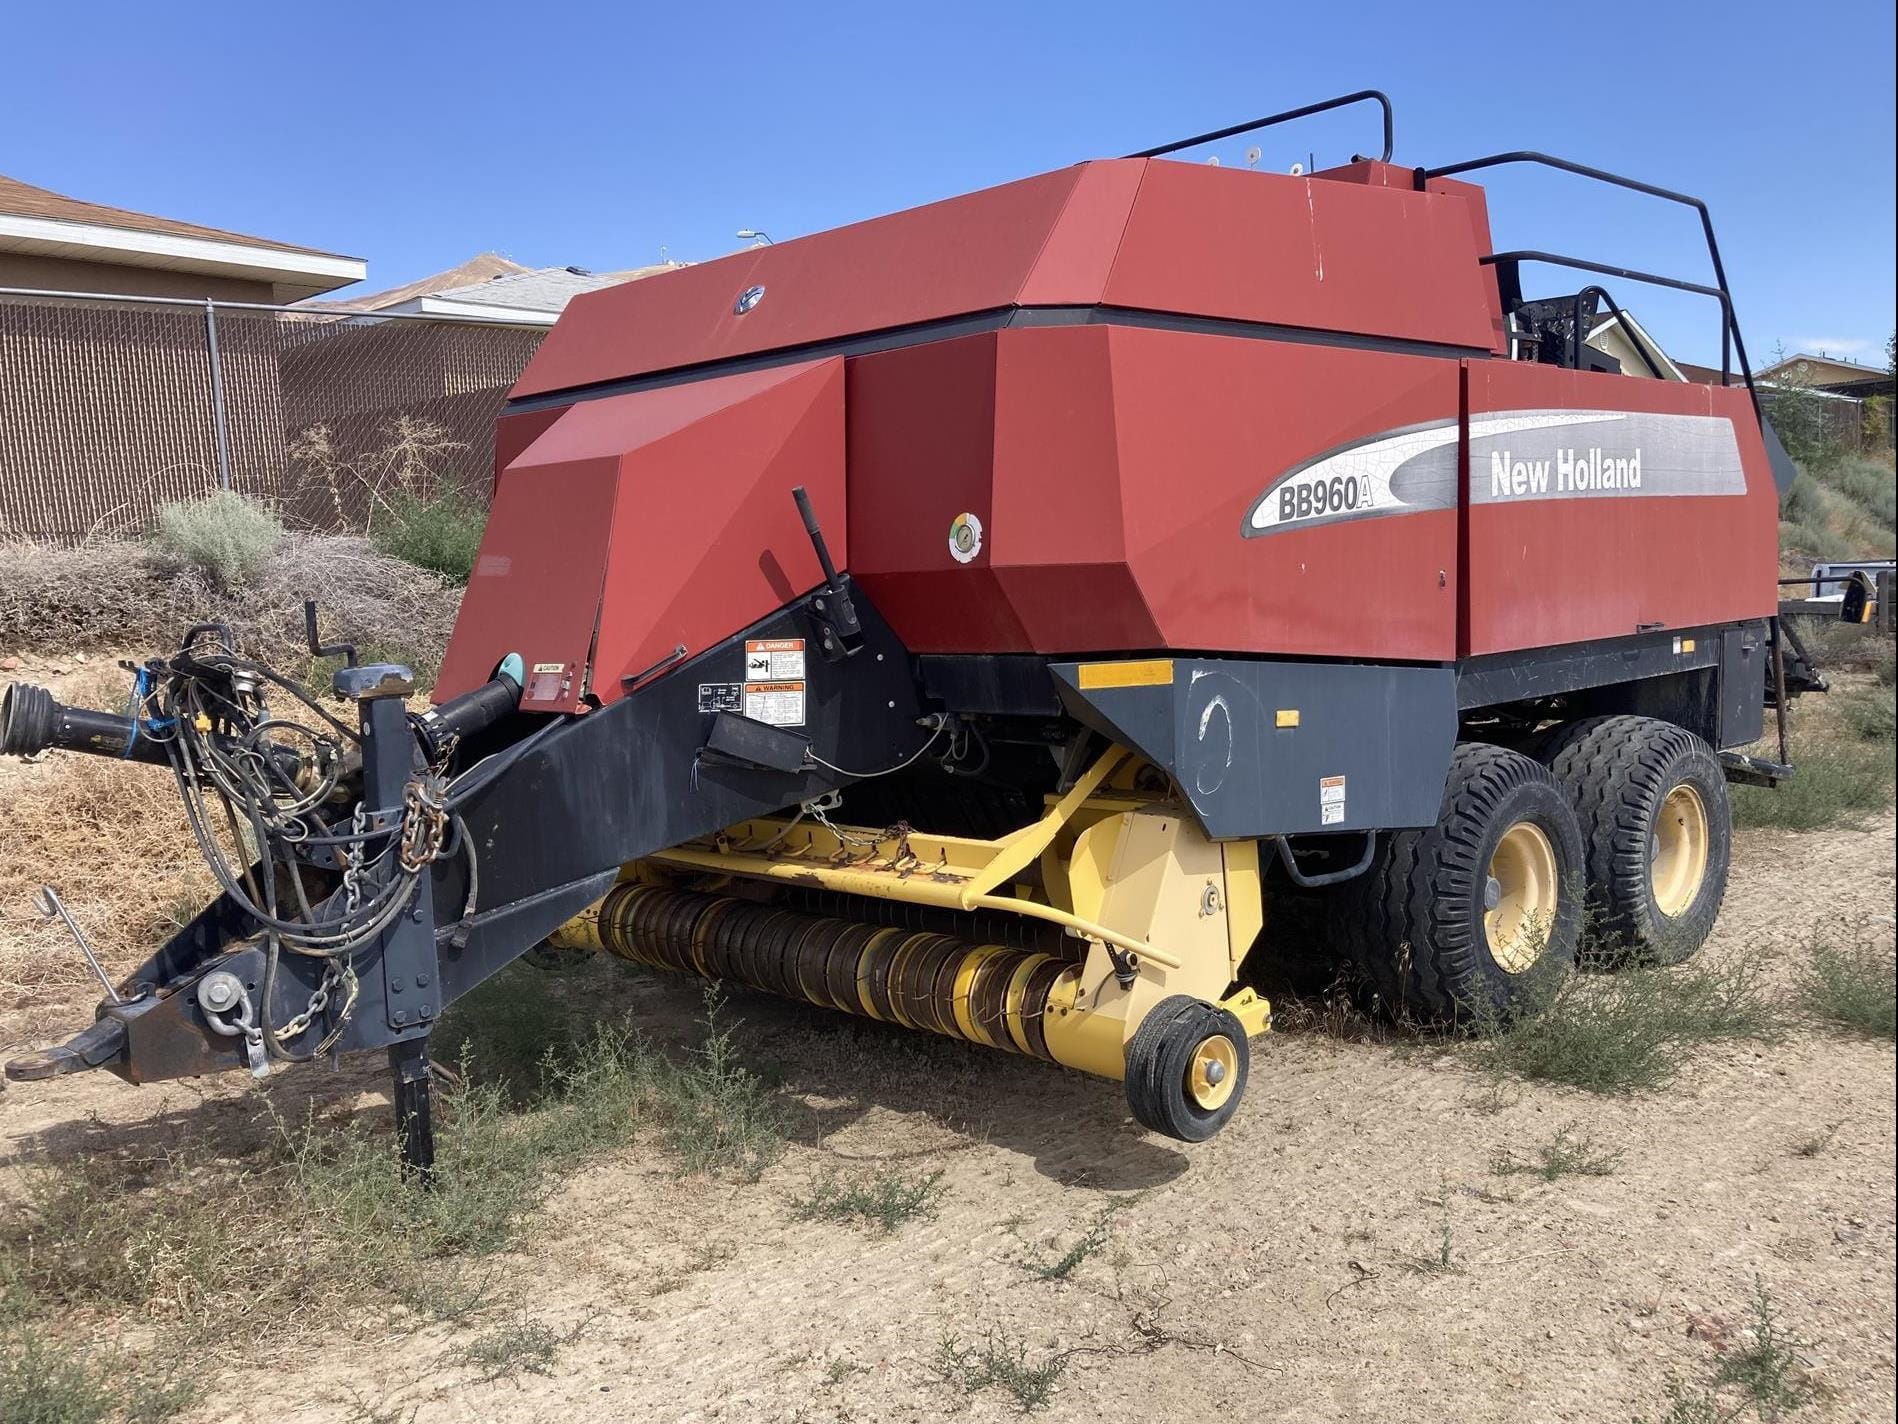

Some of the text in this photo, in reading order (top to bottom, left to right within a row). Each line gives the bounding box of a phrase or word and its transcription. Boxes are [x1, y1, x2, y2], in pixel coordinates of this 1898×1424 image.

[1491, 447, 1642, 497] New Holland
[1278, 474, 1374, 522] BB960A
[766, 641, 794, 650] DANGER
